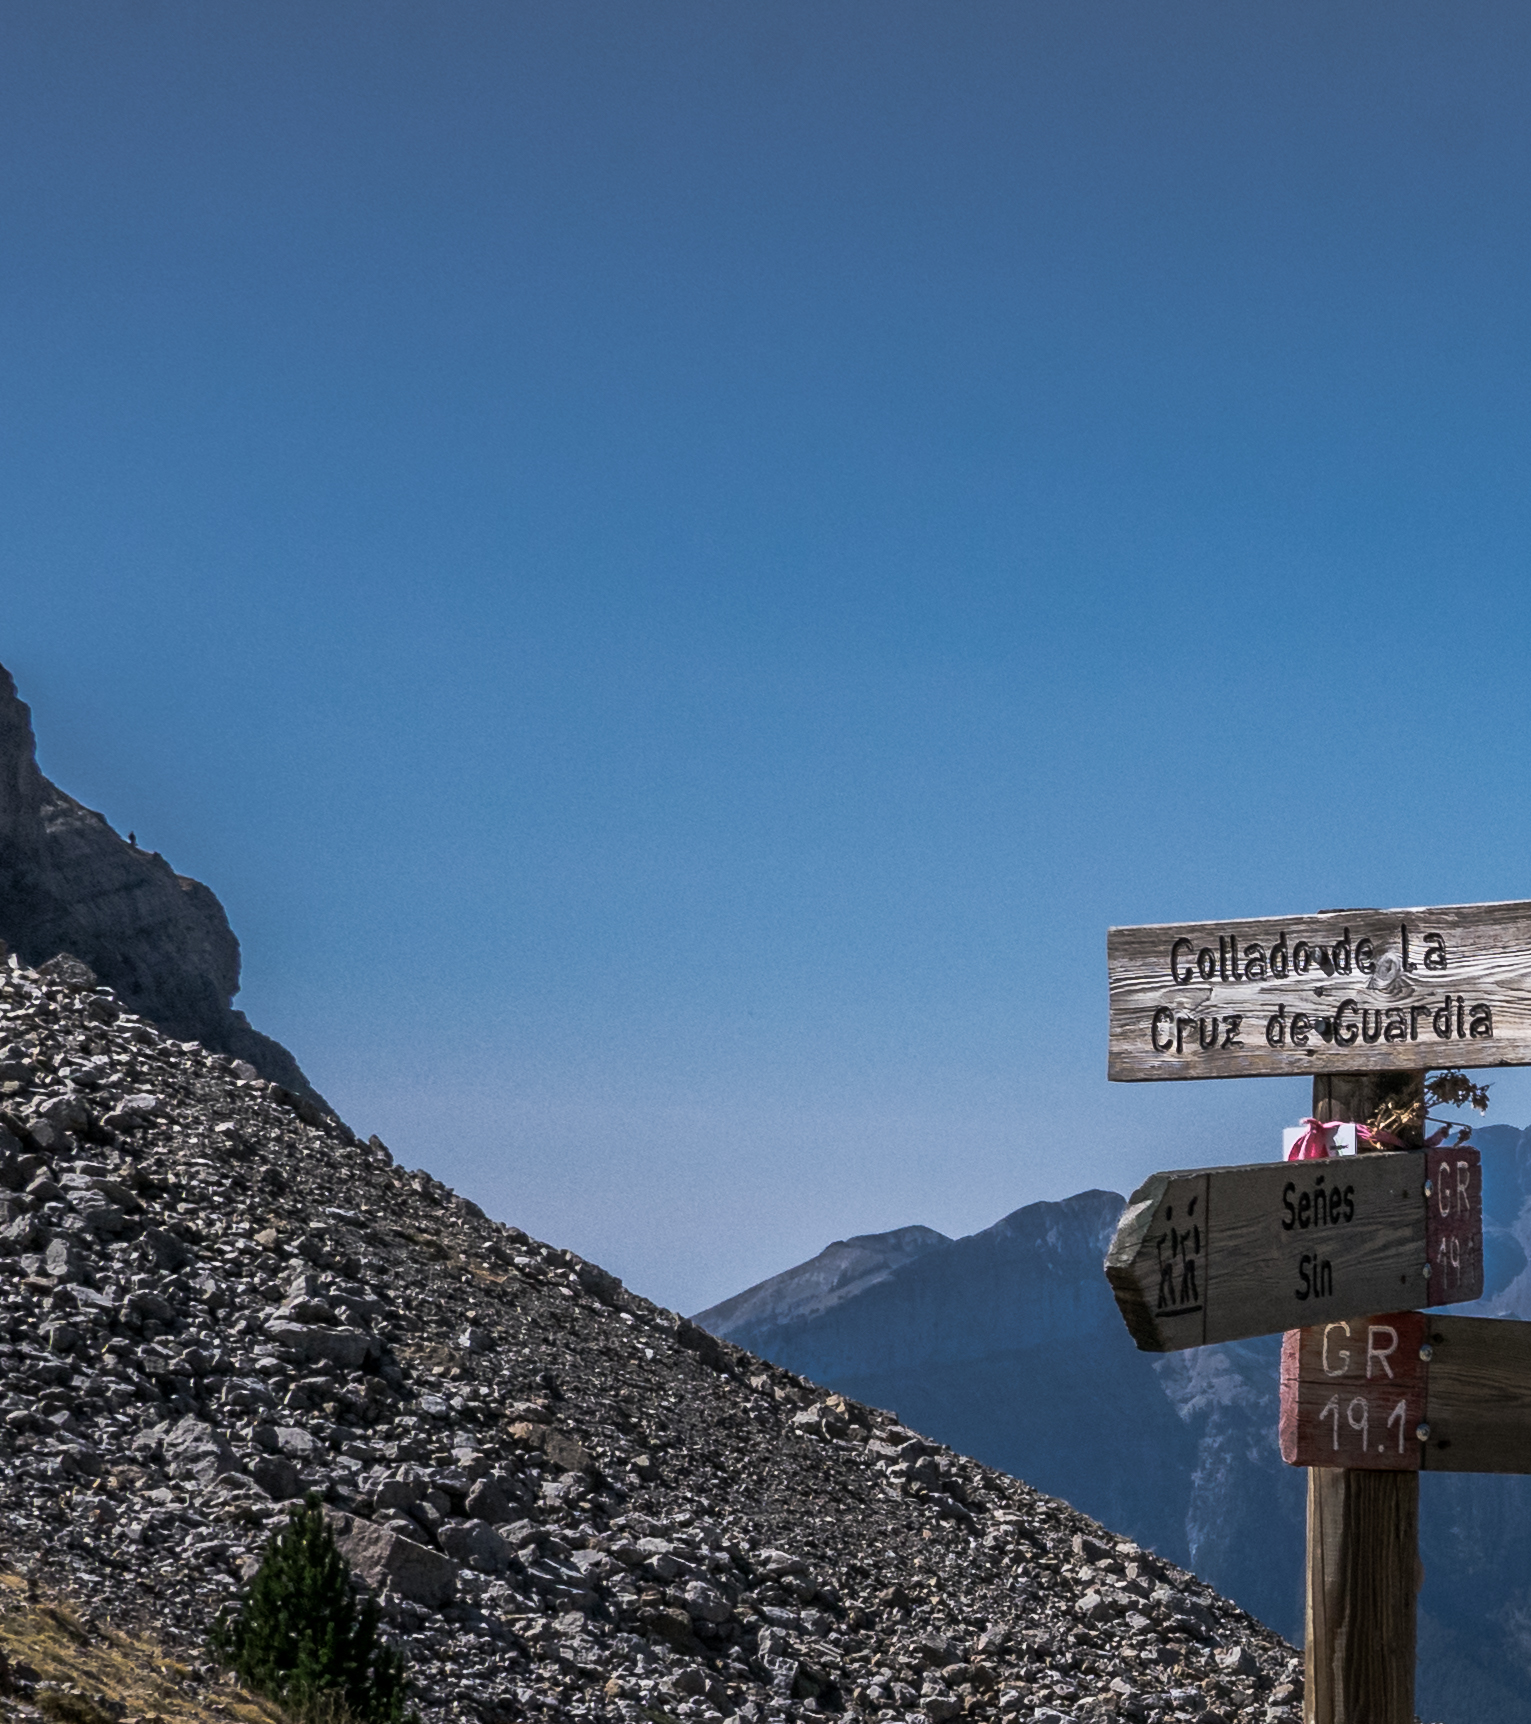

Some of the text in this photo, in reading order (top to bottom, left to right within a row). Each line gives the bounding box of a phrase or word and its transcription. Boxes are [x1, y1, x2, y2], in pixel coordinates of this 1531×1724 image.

[1170, 931, 1310, 985] Collado
[1332, 927, 1376, 976] de
[1151, 996, 1494, 1054] Cruz de Guardia
[1282, 1176, 1354, 1230] Señes
[1437, 1161, 1470, 1217] GR
[1295, 1254, 1332, 1301] Sin
[1322, 1322, 1398, 1379] GR
[1320, 1395, 1407, 1453] 19.1
